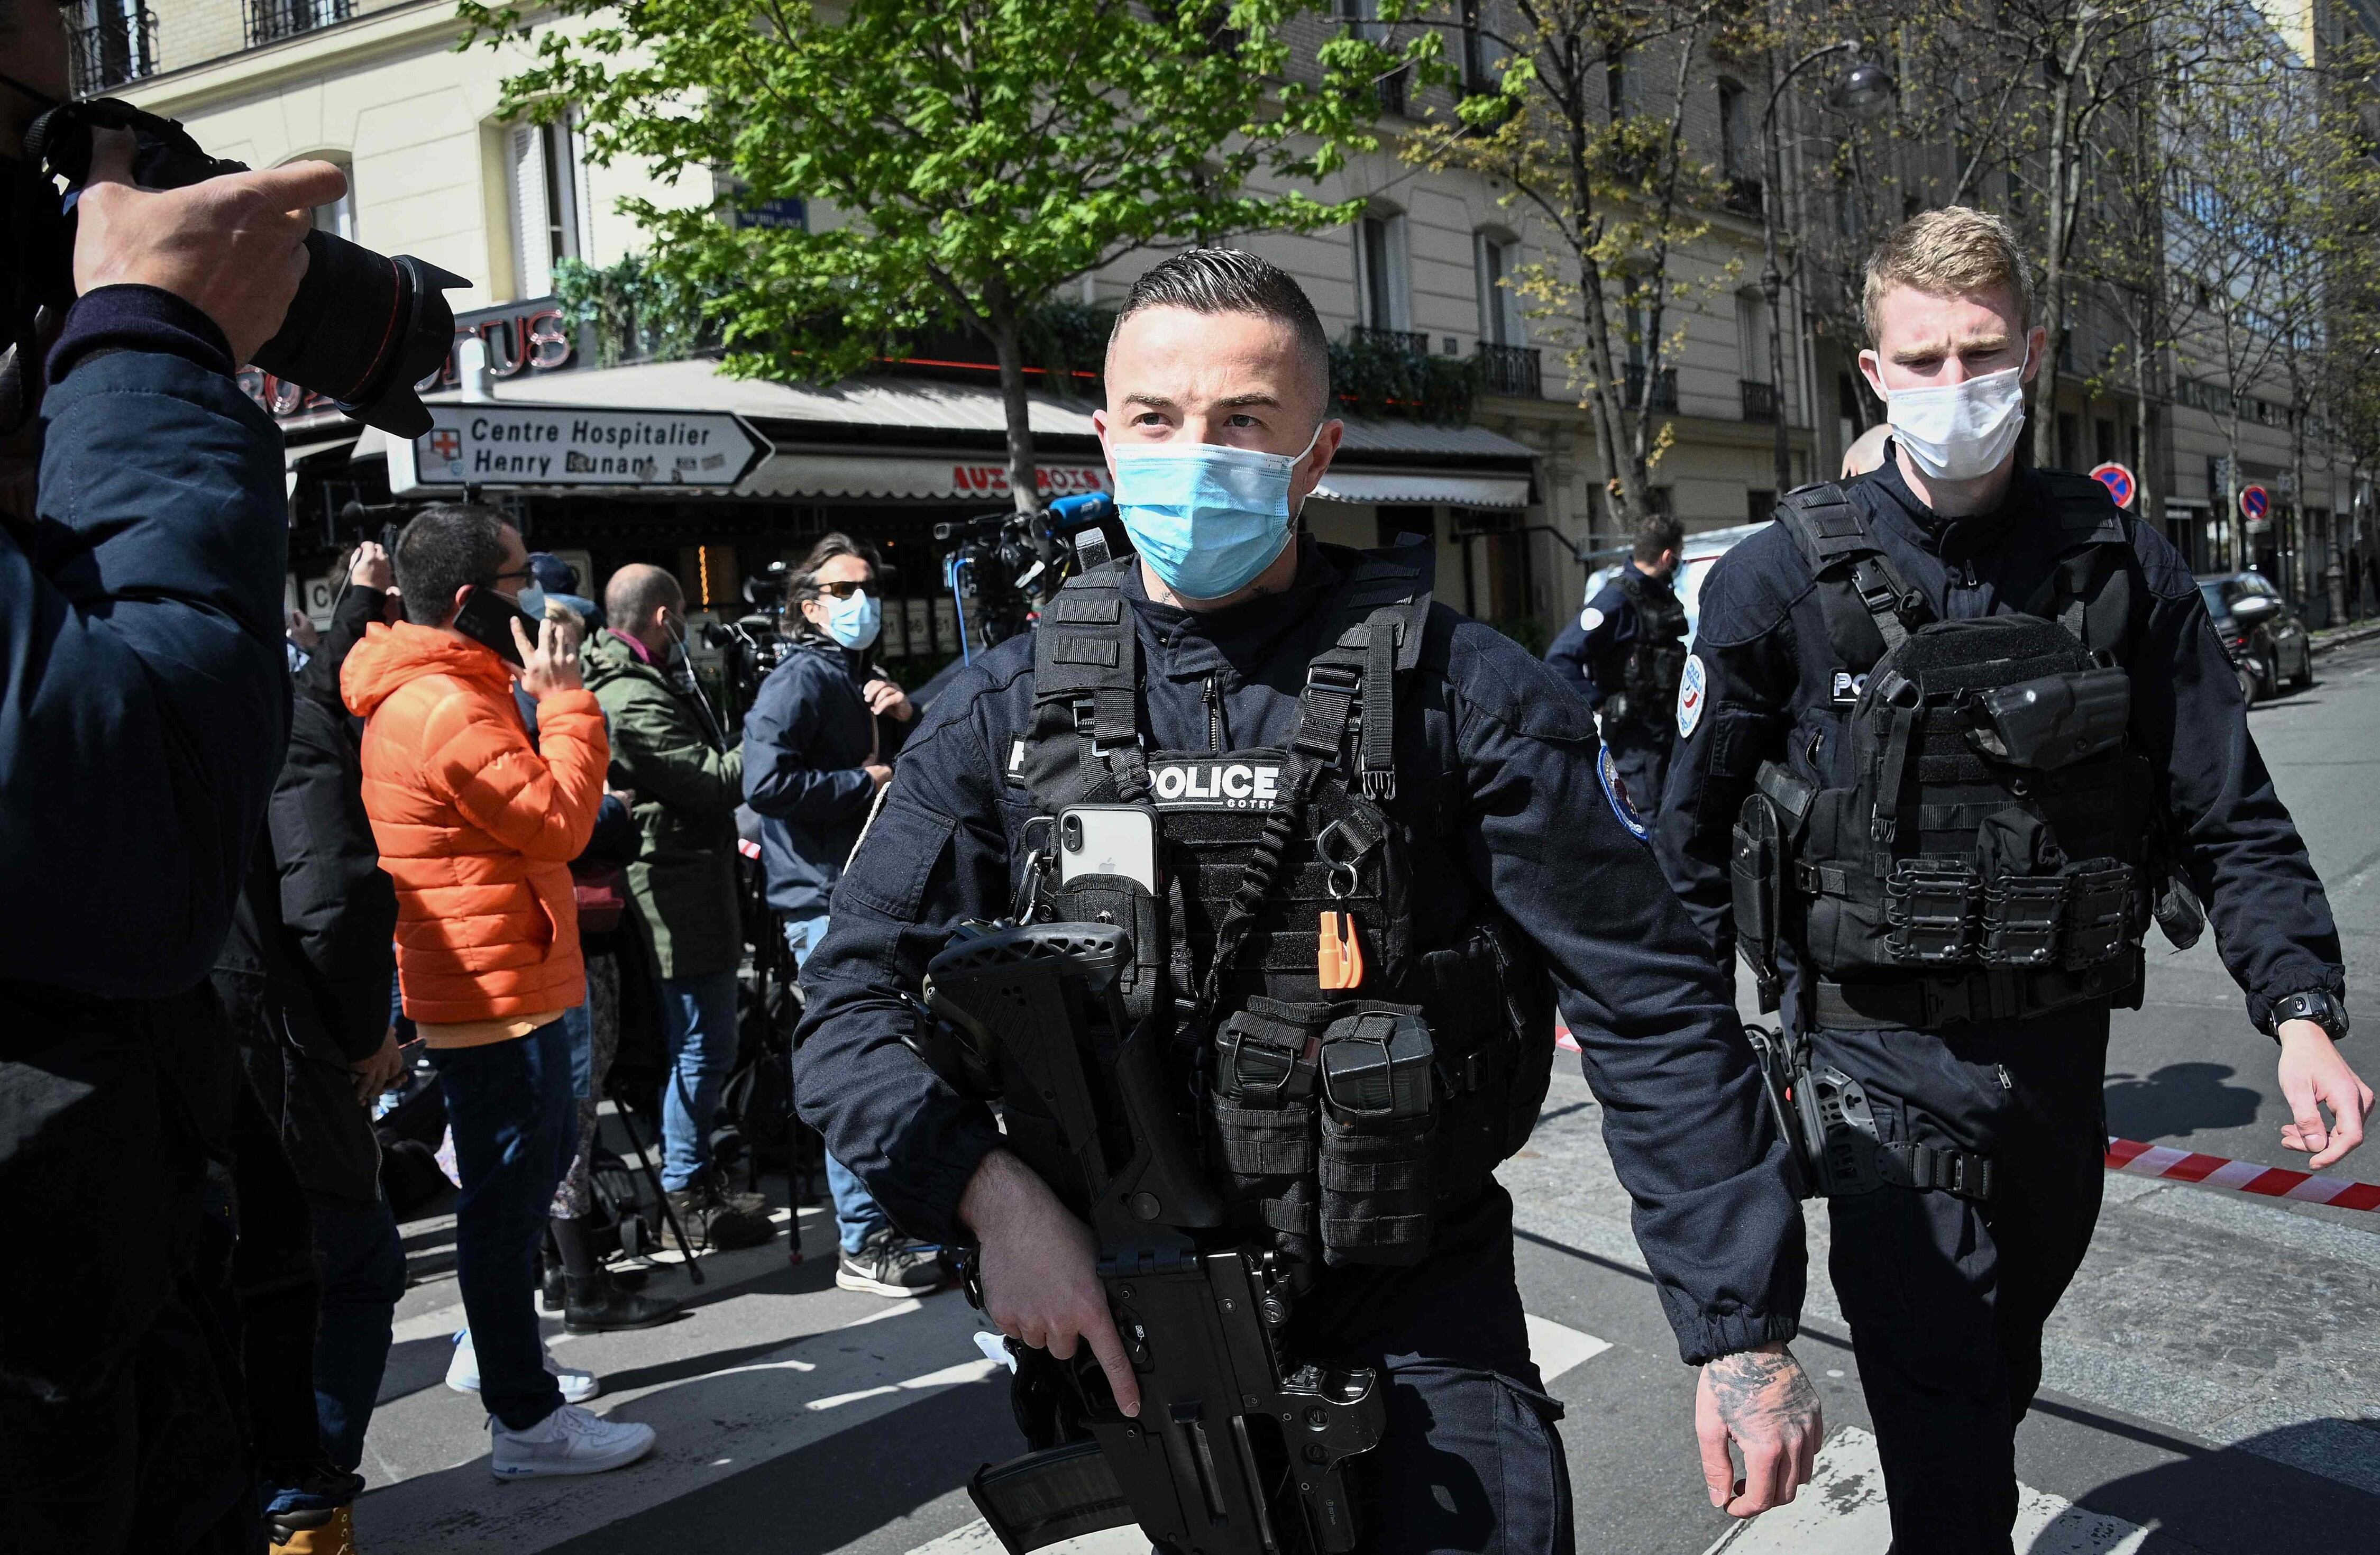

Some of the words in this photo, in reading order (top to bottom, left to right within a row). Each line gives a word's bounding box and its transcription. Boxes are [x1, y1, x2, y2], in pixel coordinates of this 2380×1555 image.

[471, 418, 559, 443] Centre
[572, 420, 710, 449] Hospitalier
[475, 450, 551, 477] Henry
[954, 466, 1009, 490] AUX
[1035, 468, 1102, 490] ROIS
